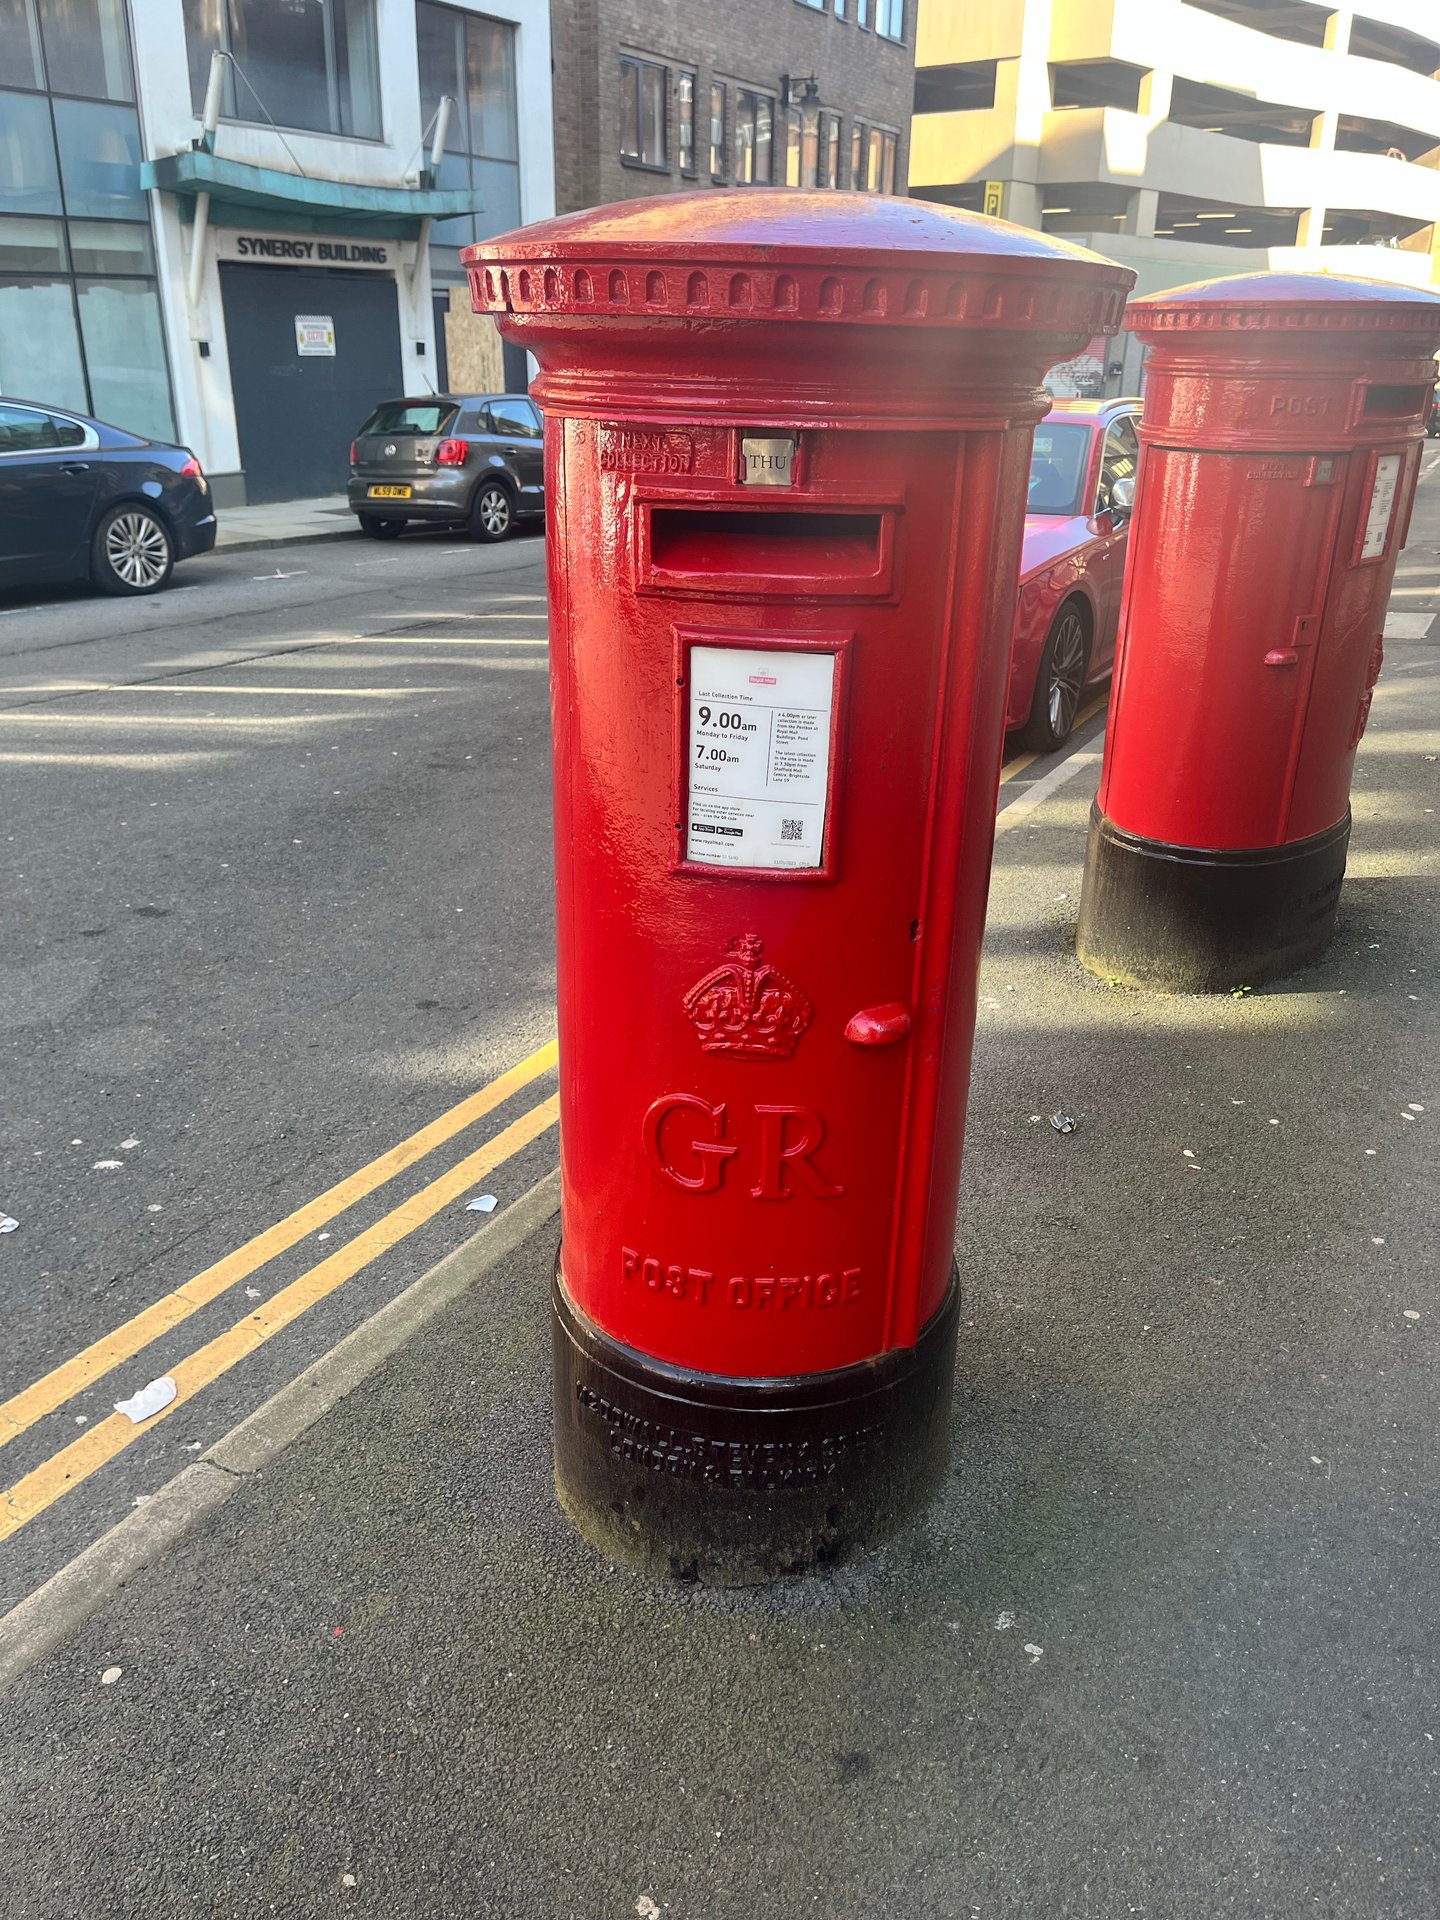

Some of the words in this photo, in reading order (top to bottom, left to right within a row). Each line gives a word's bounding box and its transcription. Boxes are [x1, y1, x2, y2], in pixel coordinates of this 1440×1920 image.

[237, 236, 313, 259] SYNERGY
[316, 243, 387, 264] BUILDING
[1269, 395, 1331, 417] POST
[621, 431, 664, 450] NEXT
[600, 450, 691, 472] COLLECTION
[749, 455, 787, 470] THU
[711, 691, 739, 700] Collection
[698, 706, 757, 731] 9.00am
[696, 730, 720, 739] Monday
[729, 733, 749, 742] Friday
[696, 744, 739, 763] 7.00am
[694, 762, 721, 772] Saturday
[693, 783, 718, 793] Services
[691, 838, 735, 847] www.royalmail.com
[641, 1093, 846, 1201] GR
[621, 1246, 715, 1305] POST
[726, 1266, 863, 1311] OFFICE
